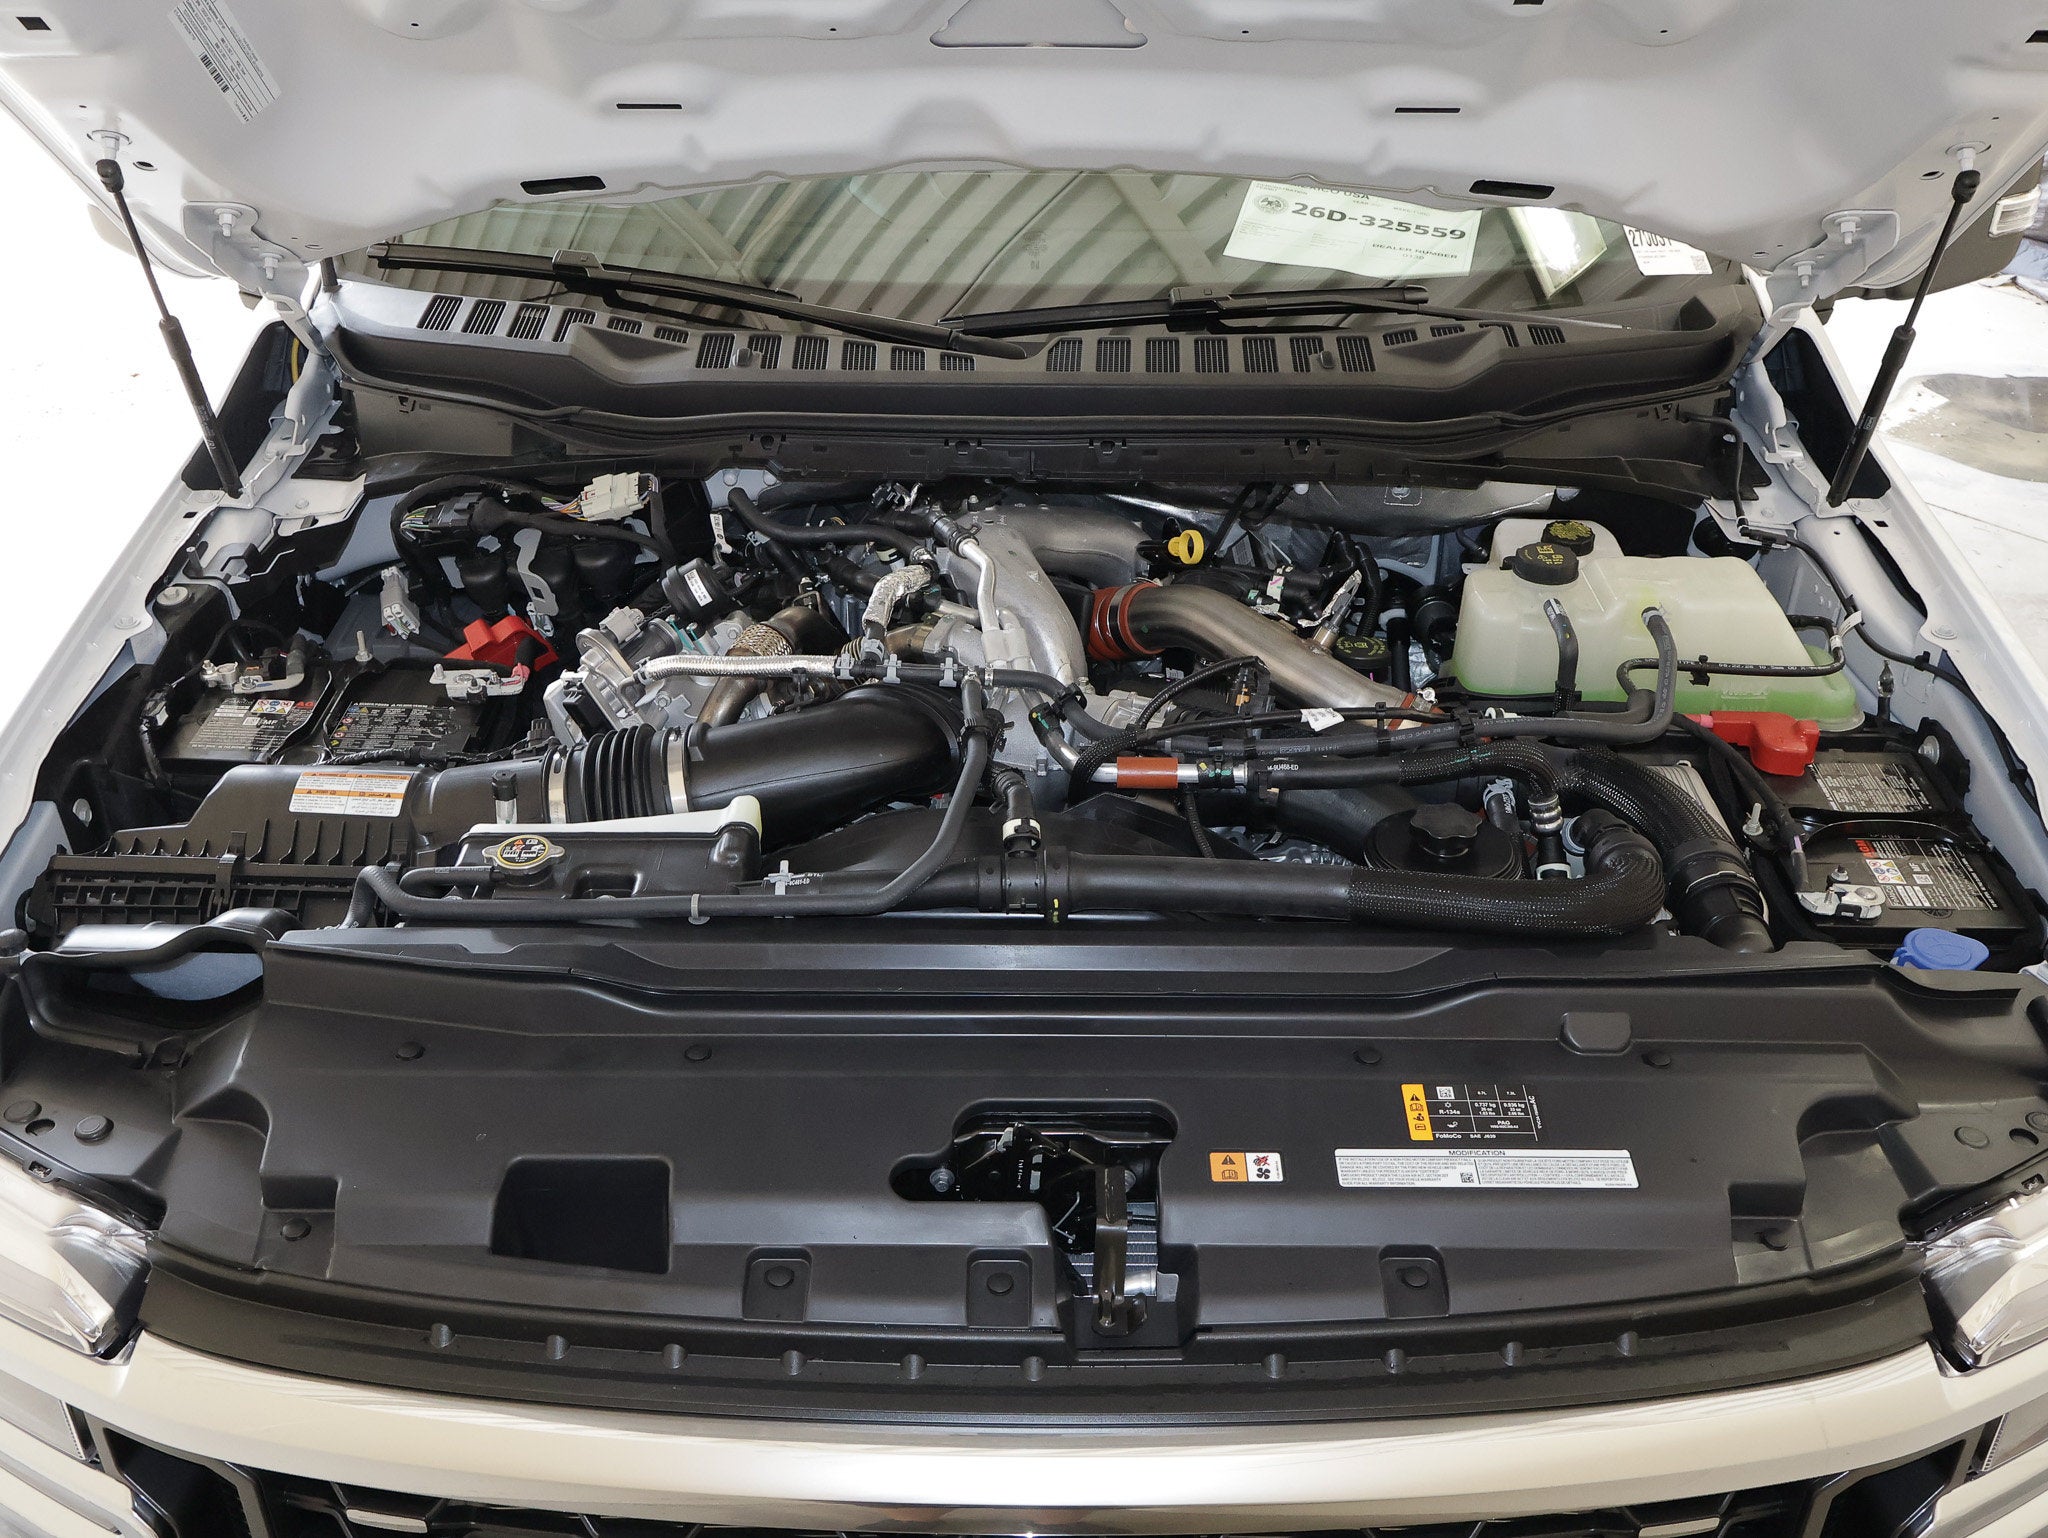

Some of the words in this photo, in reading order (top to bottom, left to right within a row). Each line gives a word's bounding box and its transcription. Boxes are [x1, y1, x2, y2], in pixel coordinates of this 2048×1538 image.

[1291, 202, 1466, 240] 26D-325559
[1372, 243, 1412, 252] DEALER
[1415, 248, 1458, 259] NUMBER
